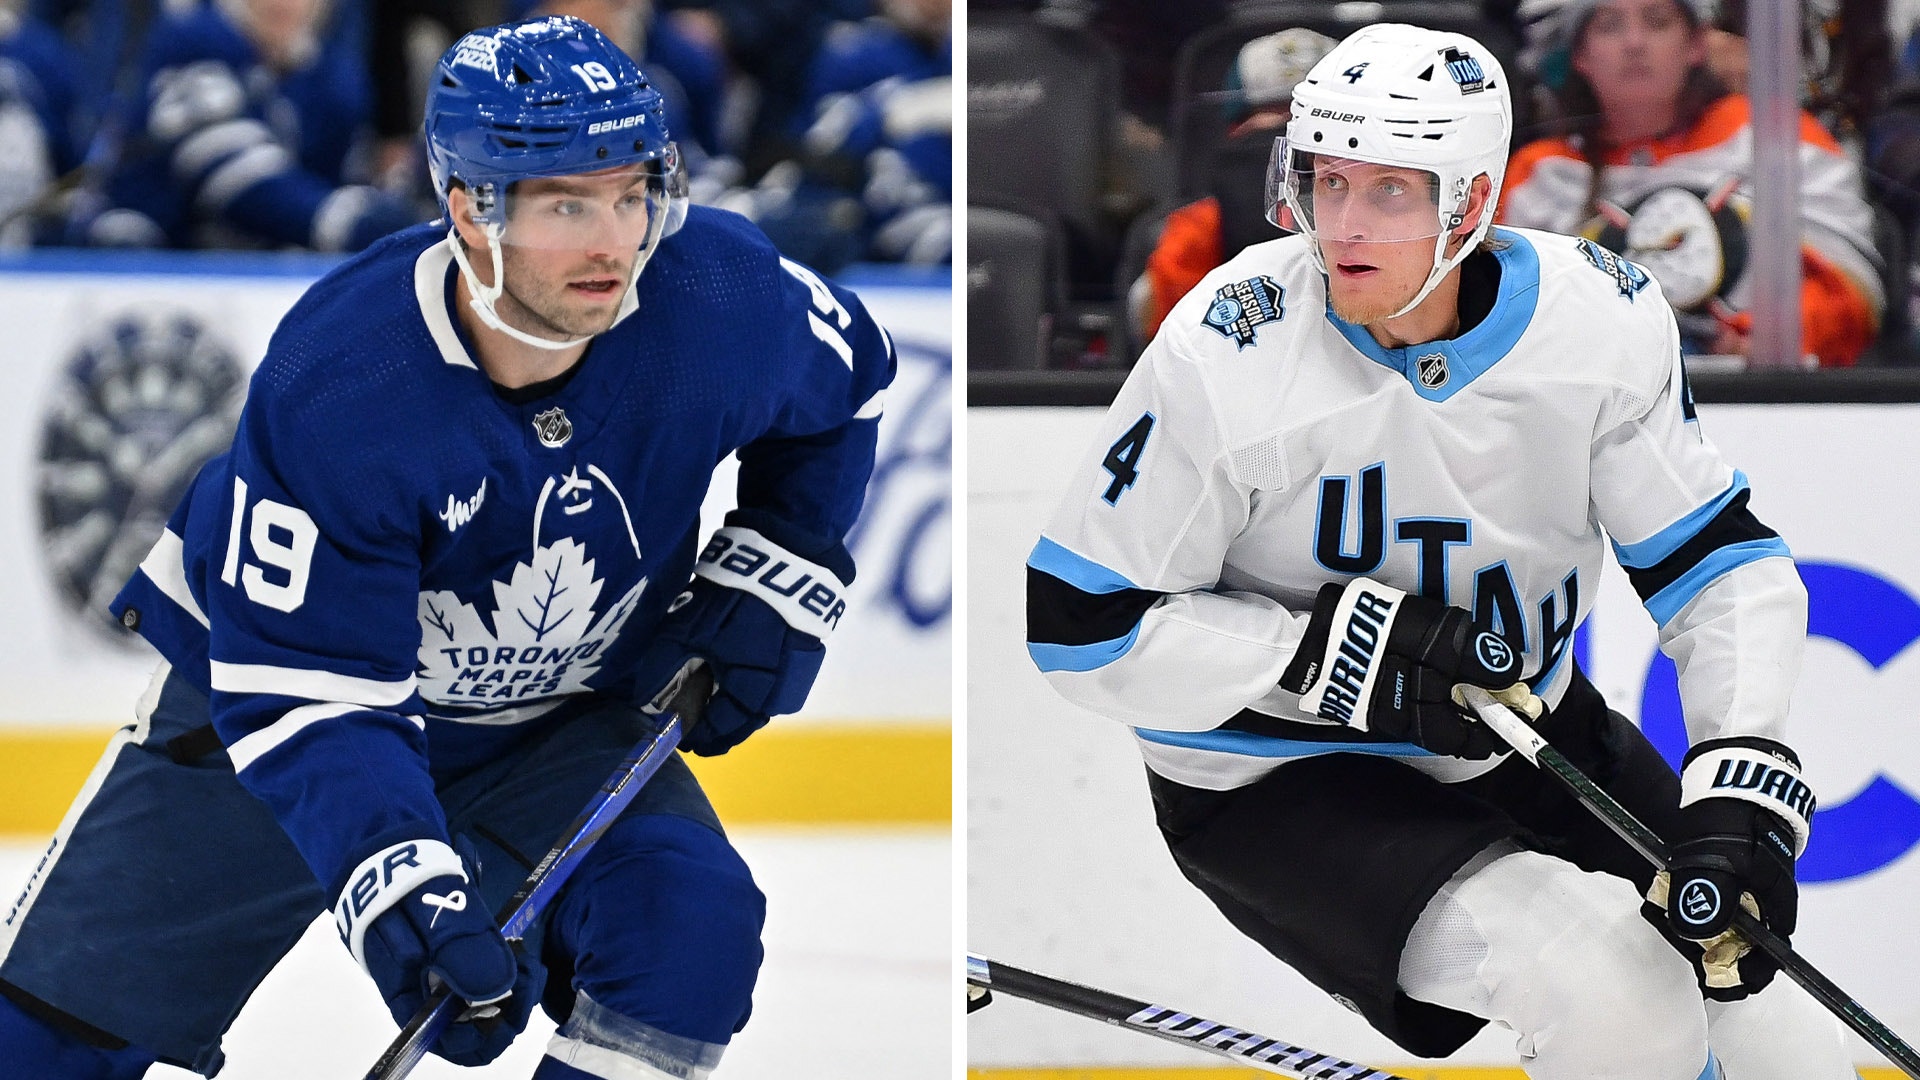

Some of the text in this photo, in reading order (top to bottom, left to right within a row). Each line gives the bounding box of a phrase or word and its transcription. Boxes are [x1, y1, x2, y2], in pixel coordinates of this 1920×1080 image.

[571, 61, 616, 93] 19
[1342, 62, 1370, 84] 4
[1446, 57, 1484, 83] UTAH
[588, 114, 645, 135] BAUER
[1311, 108, 1366, 124] BAUER
[1234, 281, 1265, 326] SEASON
[1101, 410, 1157, 508] 4
[221, 475, 319, 613] 19
[698, 535, 846, 631] BAUER
[1312, 460, 1580, 696] UTAH
[440, 639, 604, 668] TORONTO
[459, 660, 574, 683] MAPLE
[447, 677, 561, 698] LEAFS
[1394, 670, 1405, 711] COVERT
[1768, 830, 1792, 857] COVERT
